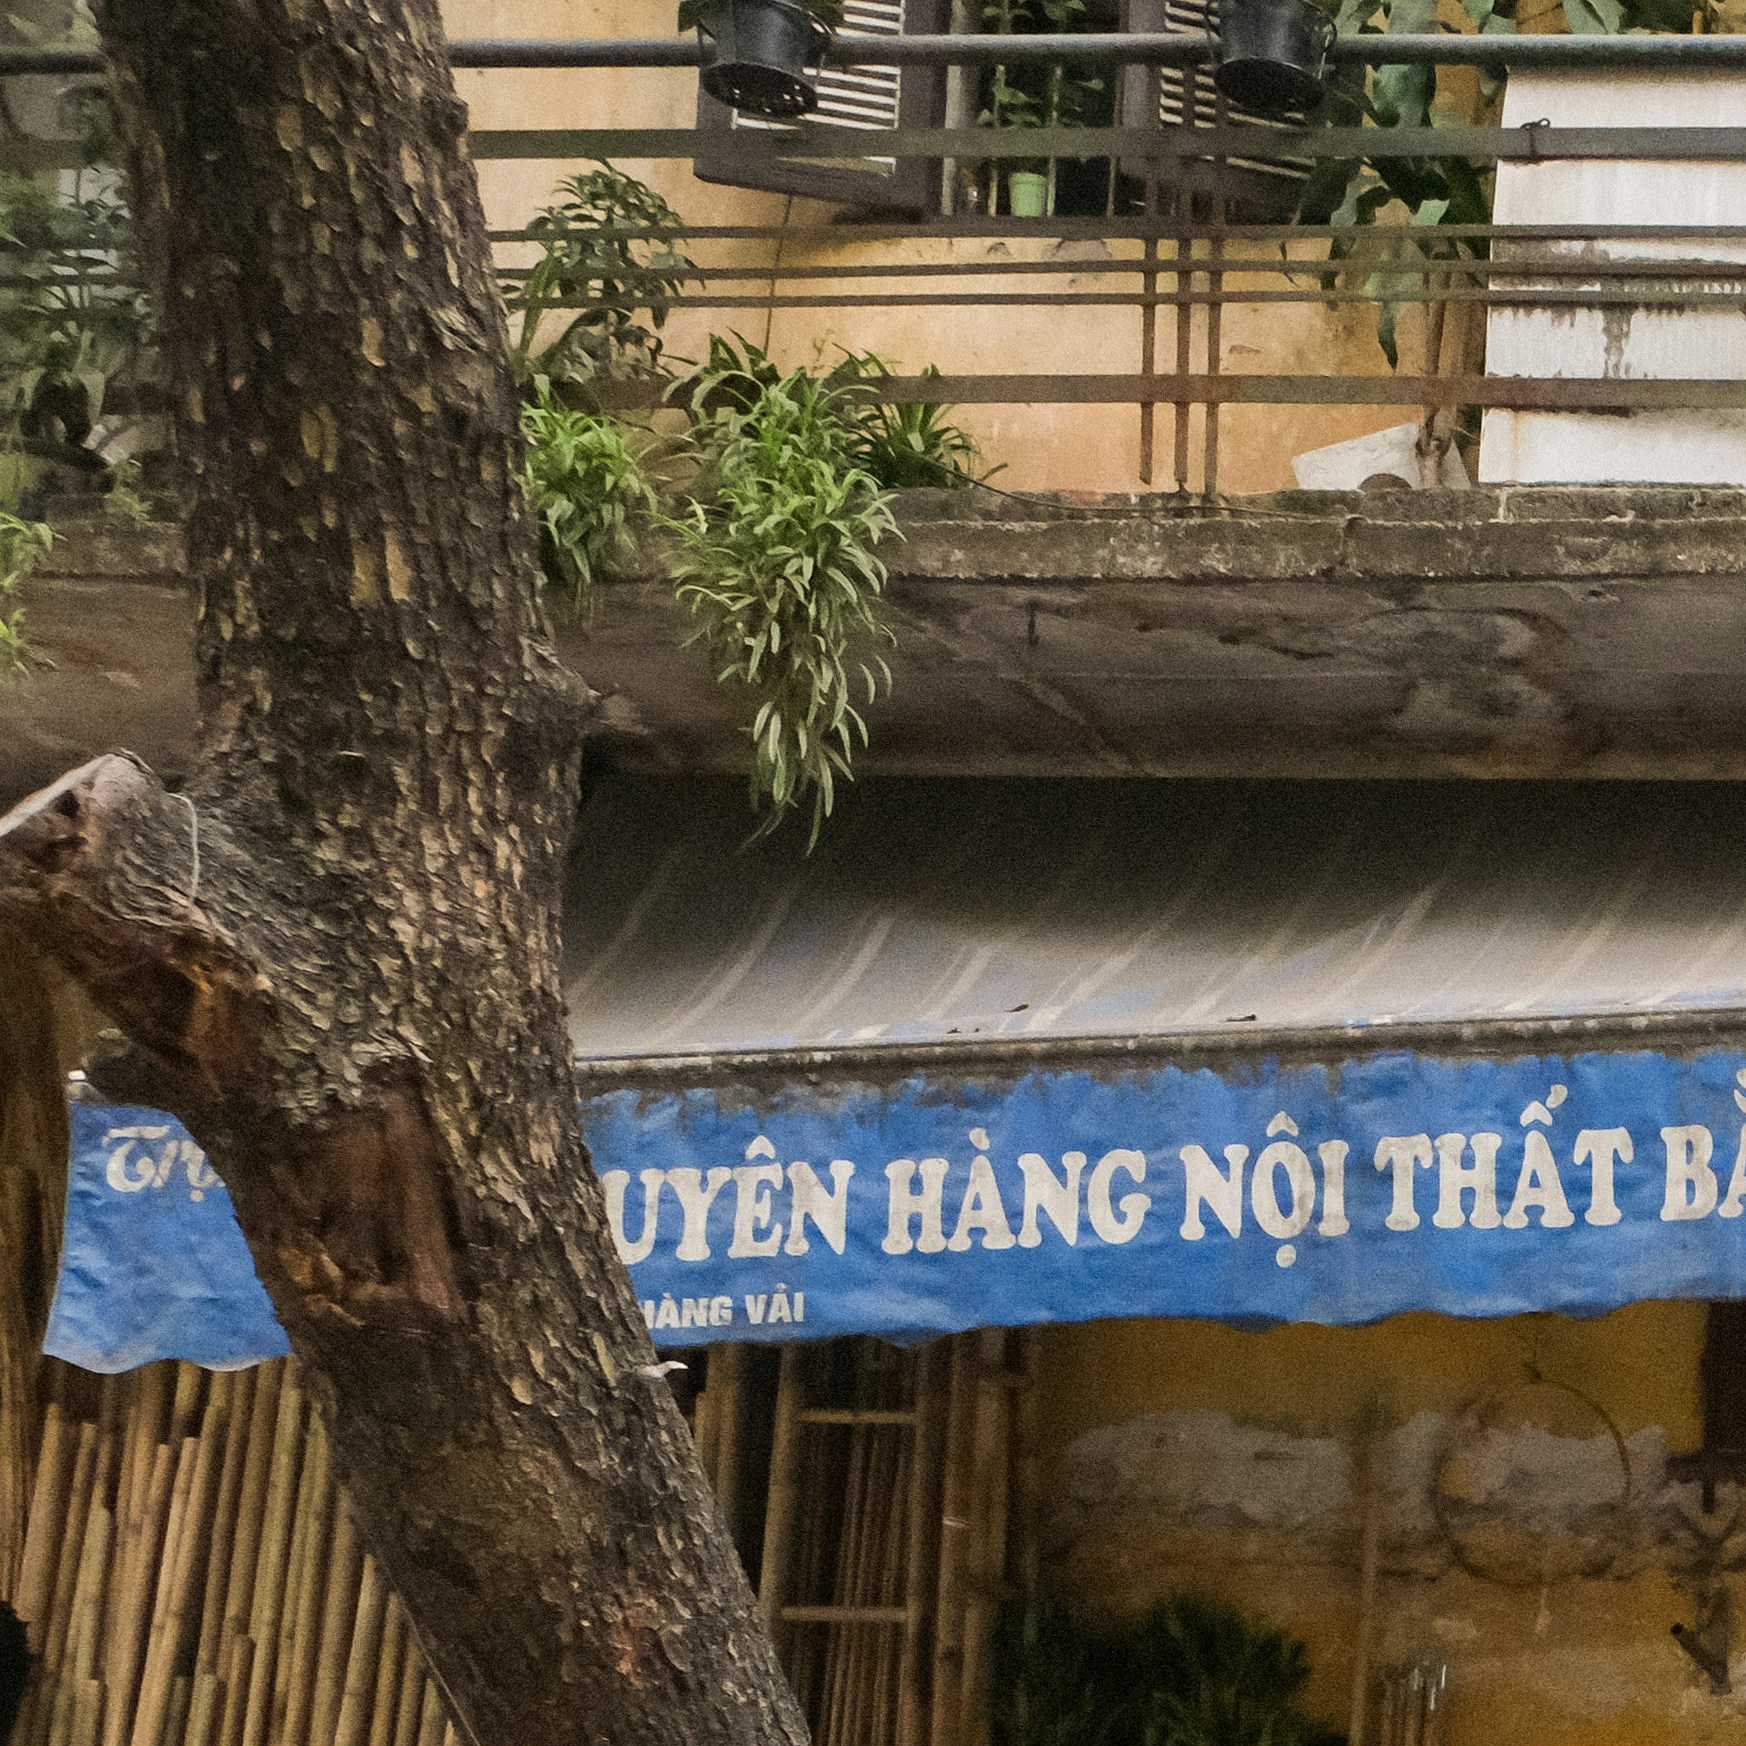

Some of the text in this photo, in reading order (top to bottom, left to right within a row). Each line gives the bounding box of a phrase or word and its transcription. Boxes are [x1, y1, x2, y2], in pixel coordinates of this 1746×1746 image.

[600, 1135, 855, 1265] UYÊN
[881, 1127, 1152, 1254] HÀNG
[1179, 1111, 1350, 1268] NỘI
[1374, 1084, 1634, 1231] THẤT
[745, 1282, 804, 1325] VẢI
